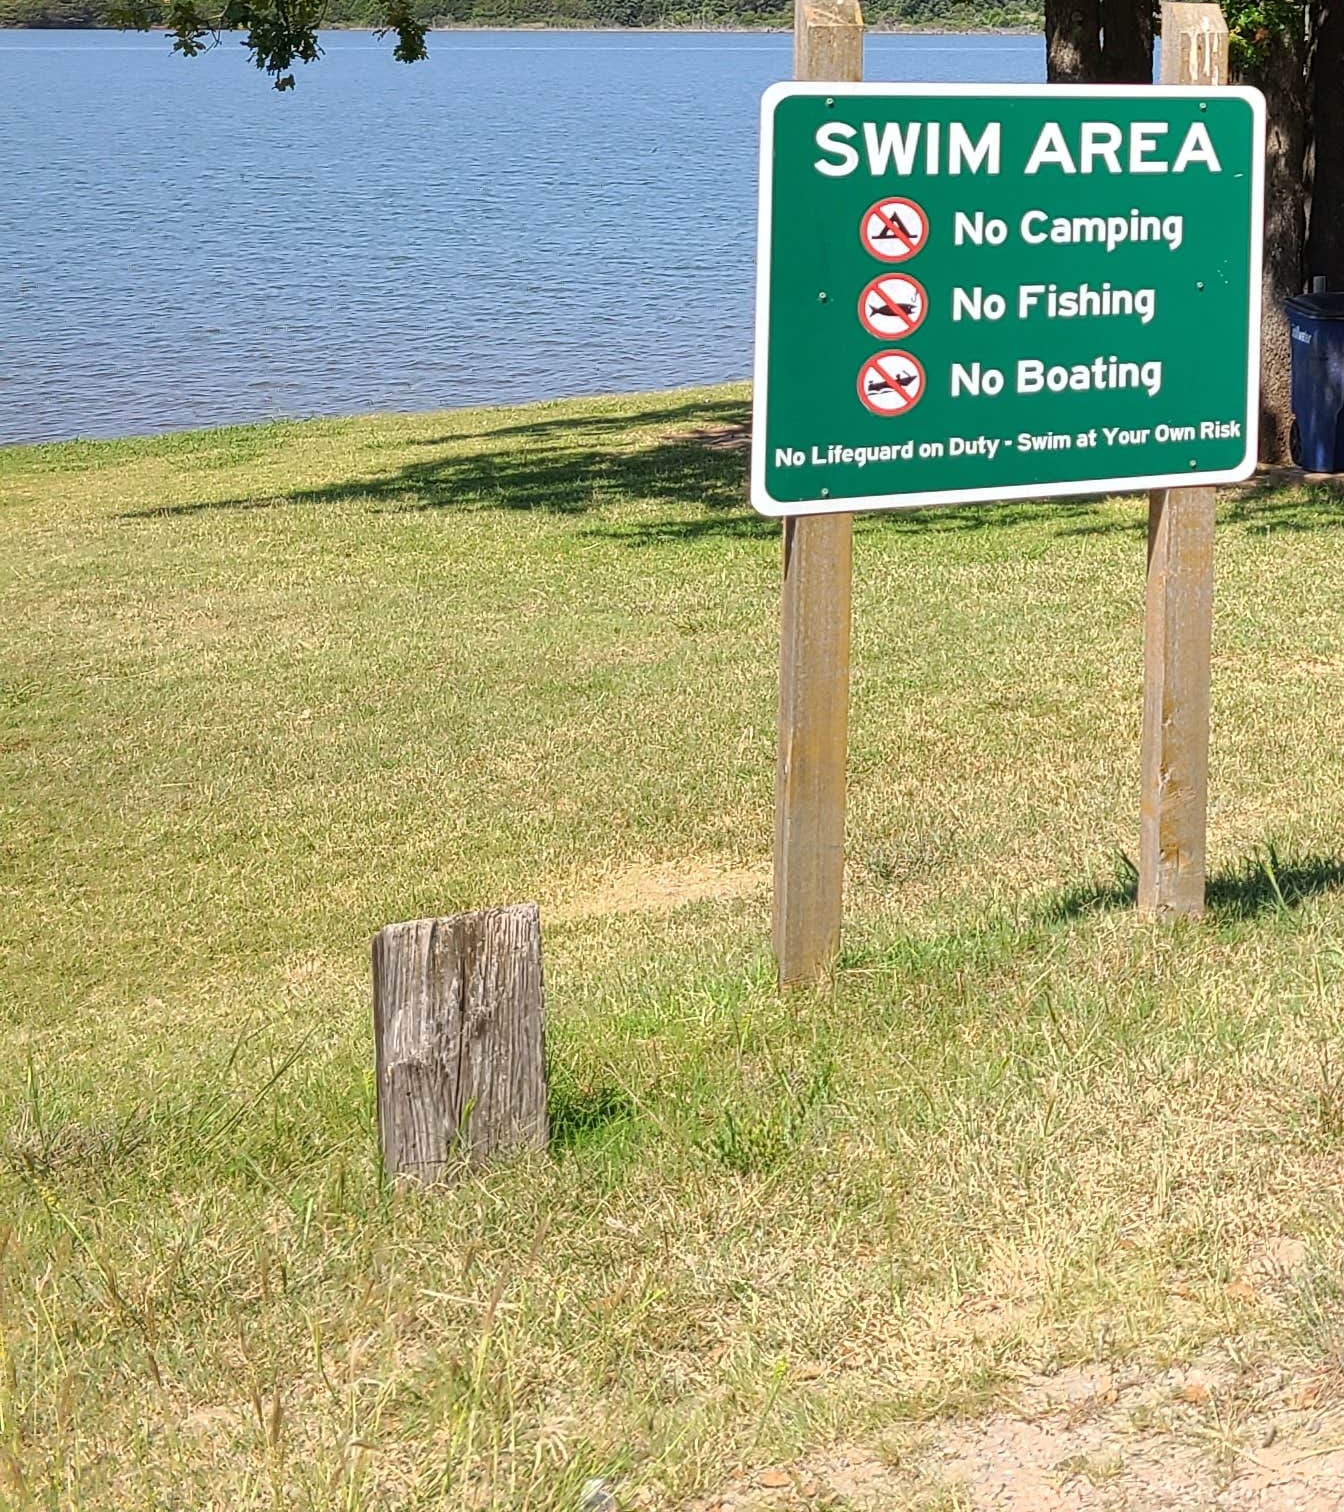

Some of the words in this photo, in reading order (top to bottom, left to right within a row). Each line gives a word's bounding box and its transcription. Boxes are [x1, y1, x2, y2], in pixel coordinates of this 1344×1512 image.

[813, 120, 1001, 178] SWIM
[1023, 120, 1223, 175] AREA
[953, 210, 1009, 247] No
[1019, 207, 1184, 253] Camping
[951, 285, 1007, 322] No
[1017, 281, 1156, 325] Fishing
[950, 361, 1006, 398] No
[1015, 354, 1163, 398] Boating
[774, 448, 806, 468] No
[810, 442, 914, 469] Lifeguard
[918, 442, 944, 459] on
[948, 435, 1001, 460] Duty
[1016, 431, 1072, 453] Swim
[1075, 428, 1098, 449] at
[1101, 425, 1151, 447] Your
[1153, 423, 1196, 444] Own
[1199, 419, 1242, 441] Risk
